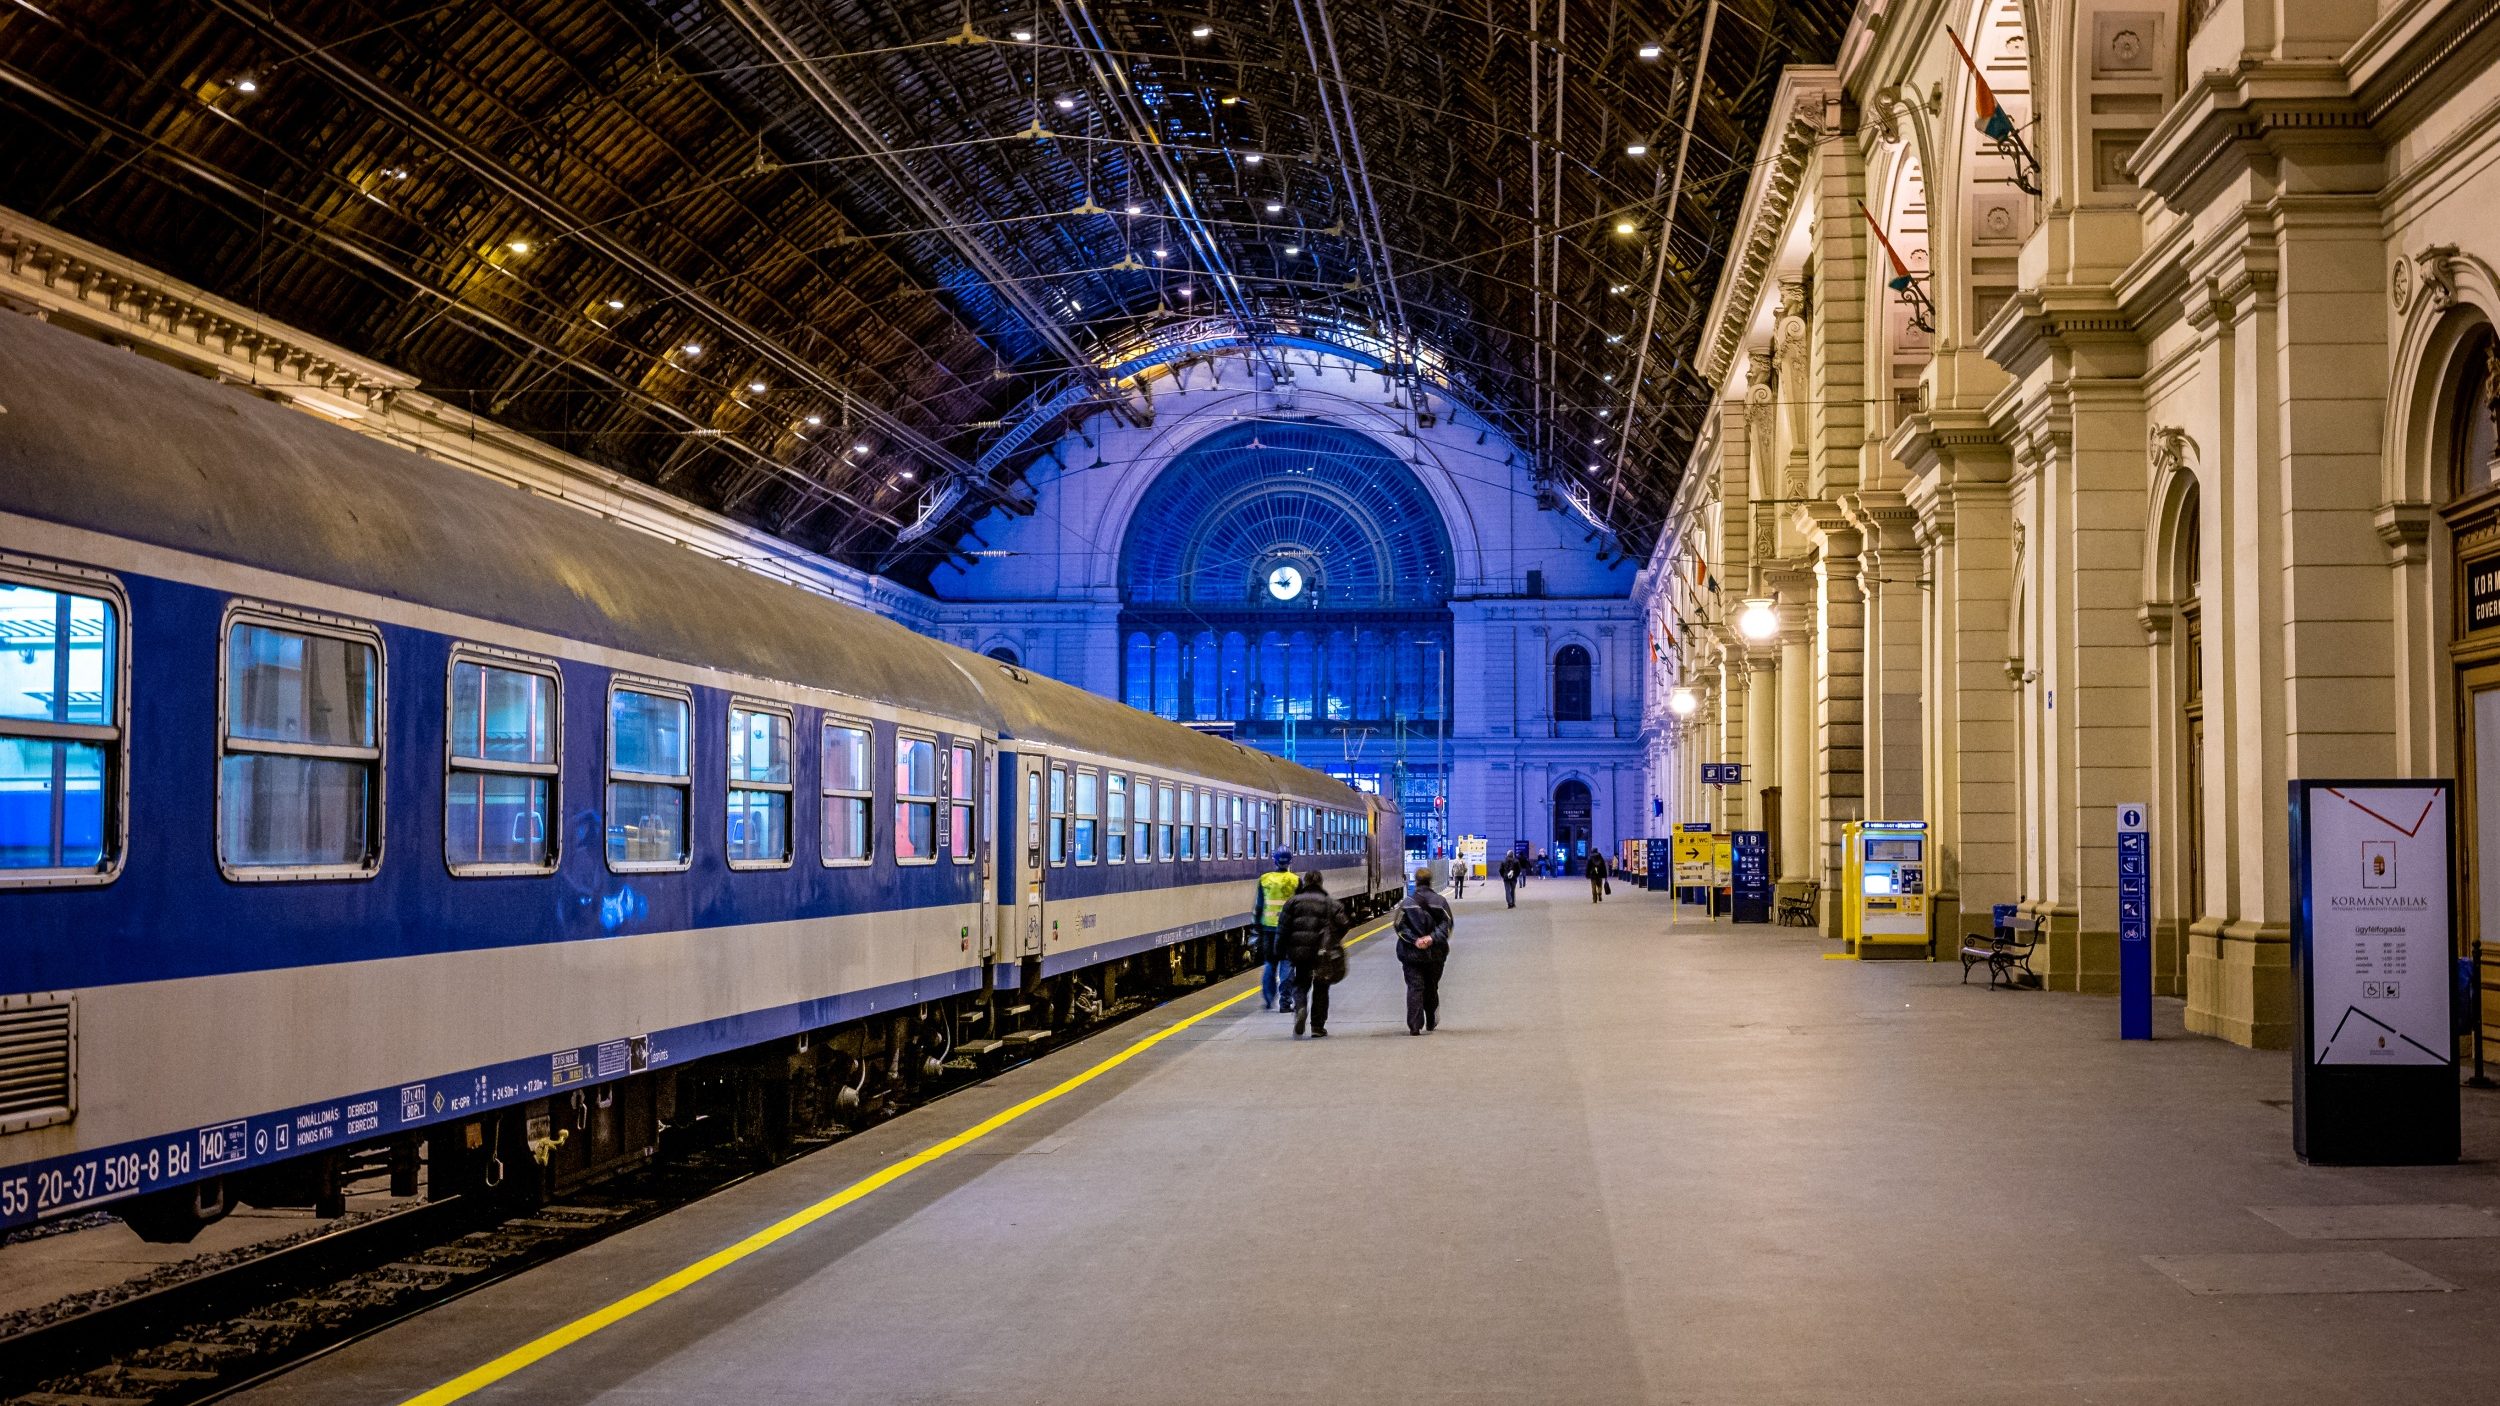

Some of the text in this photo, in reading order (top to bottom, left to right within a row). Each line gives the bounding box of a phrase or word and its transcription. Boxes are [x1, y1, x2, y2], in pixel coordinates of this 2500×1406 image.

[941, 753, 947, 781] 2
[1738, 835, 1757, 843] 6 B
[2331, 895, 2428, 906] KORMÁNYABLAK
[347, 1100, 378, 1119] DEBRECEN
[297, 1131, 319, 1147] HONOS
[347, 1116, 378, 1135] DEBRECEN
[201, 1131, 223, 1163] 140
[2, 1177, 28, 1216] 55
[37, 1161, 98, 1208] 20-37
[105, 1149, 159, 1192] 508-8
[168, 1141, 190, 1178] Bd
